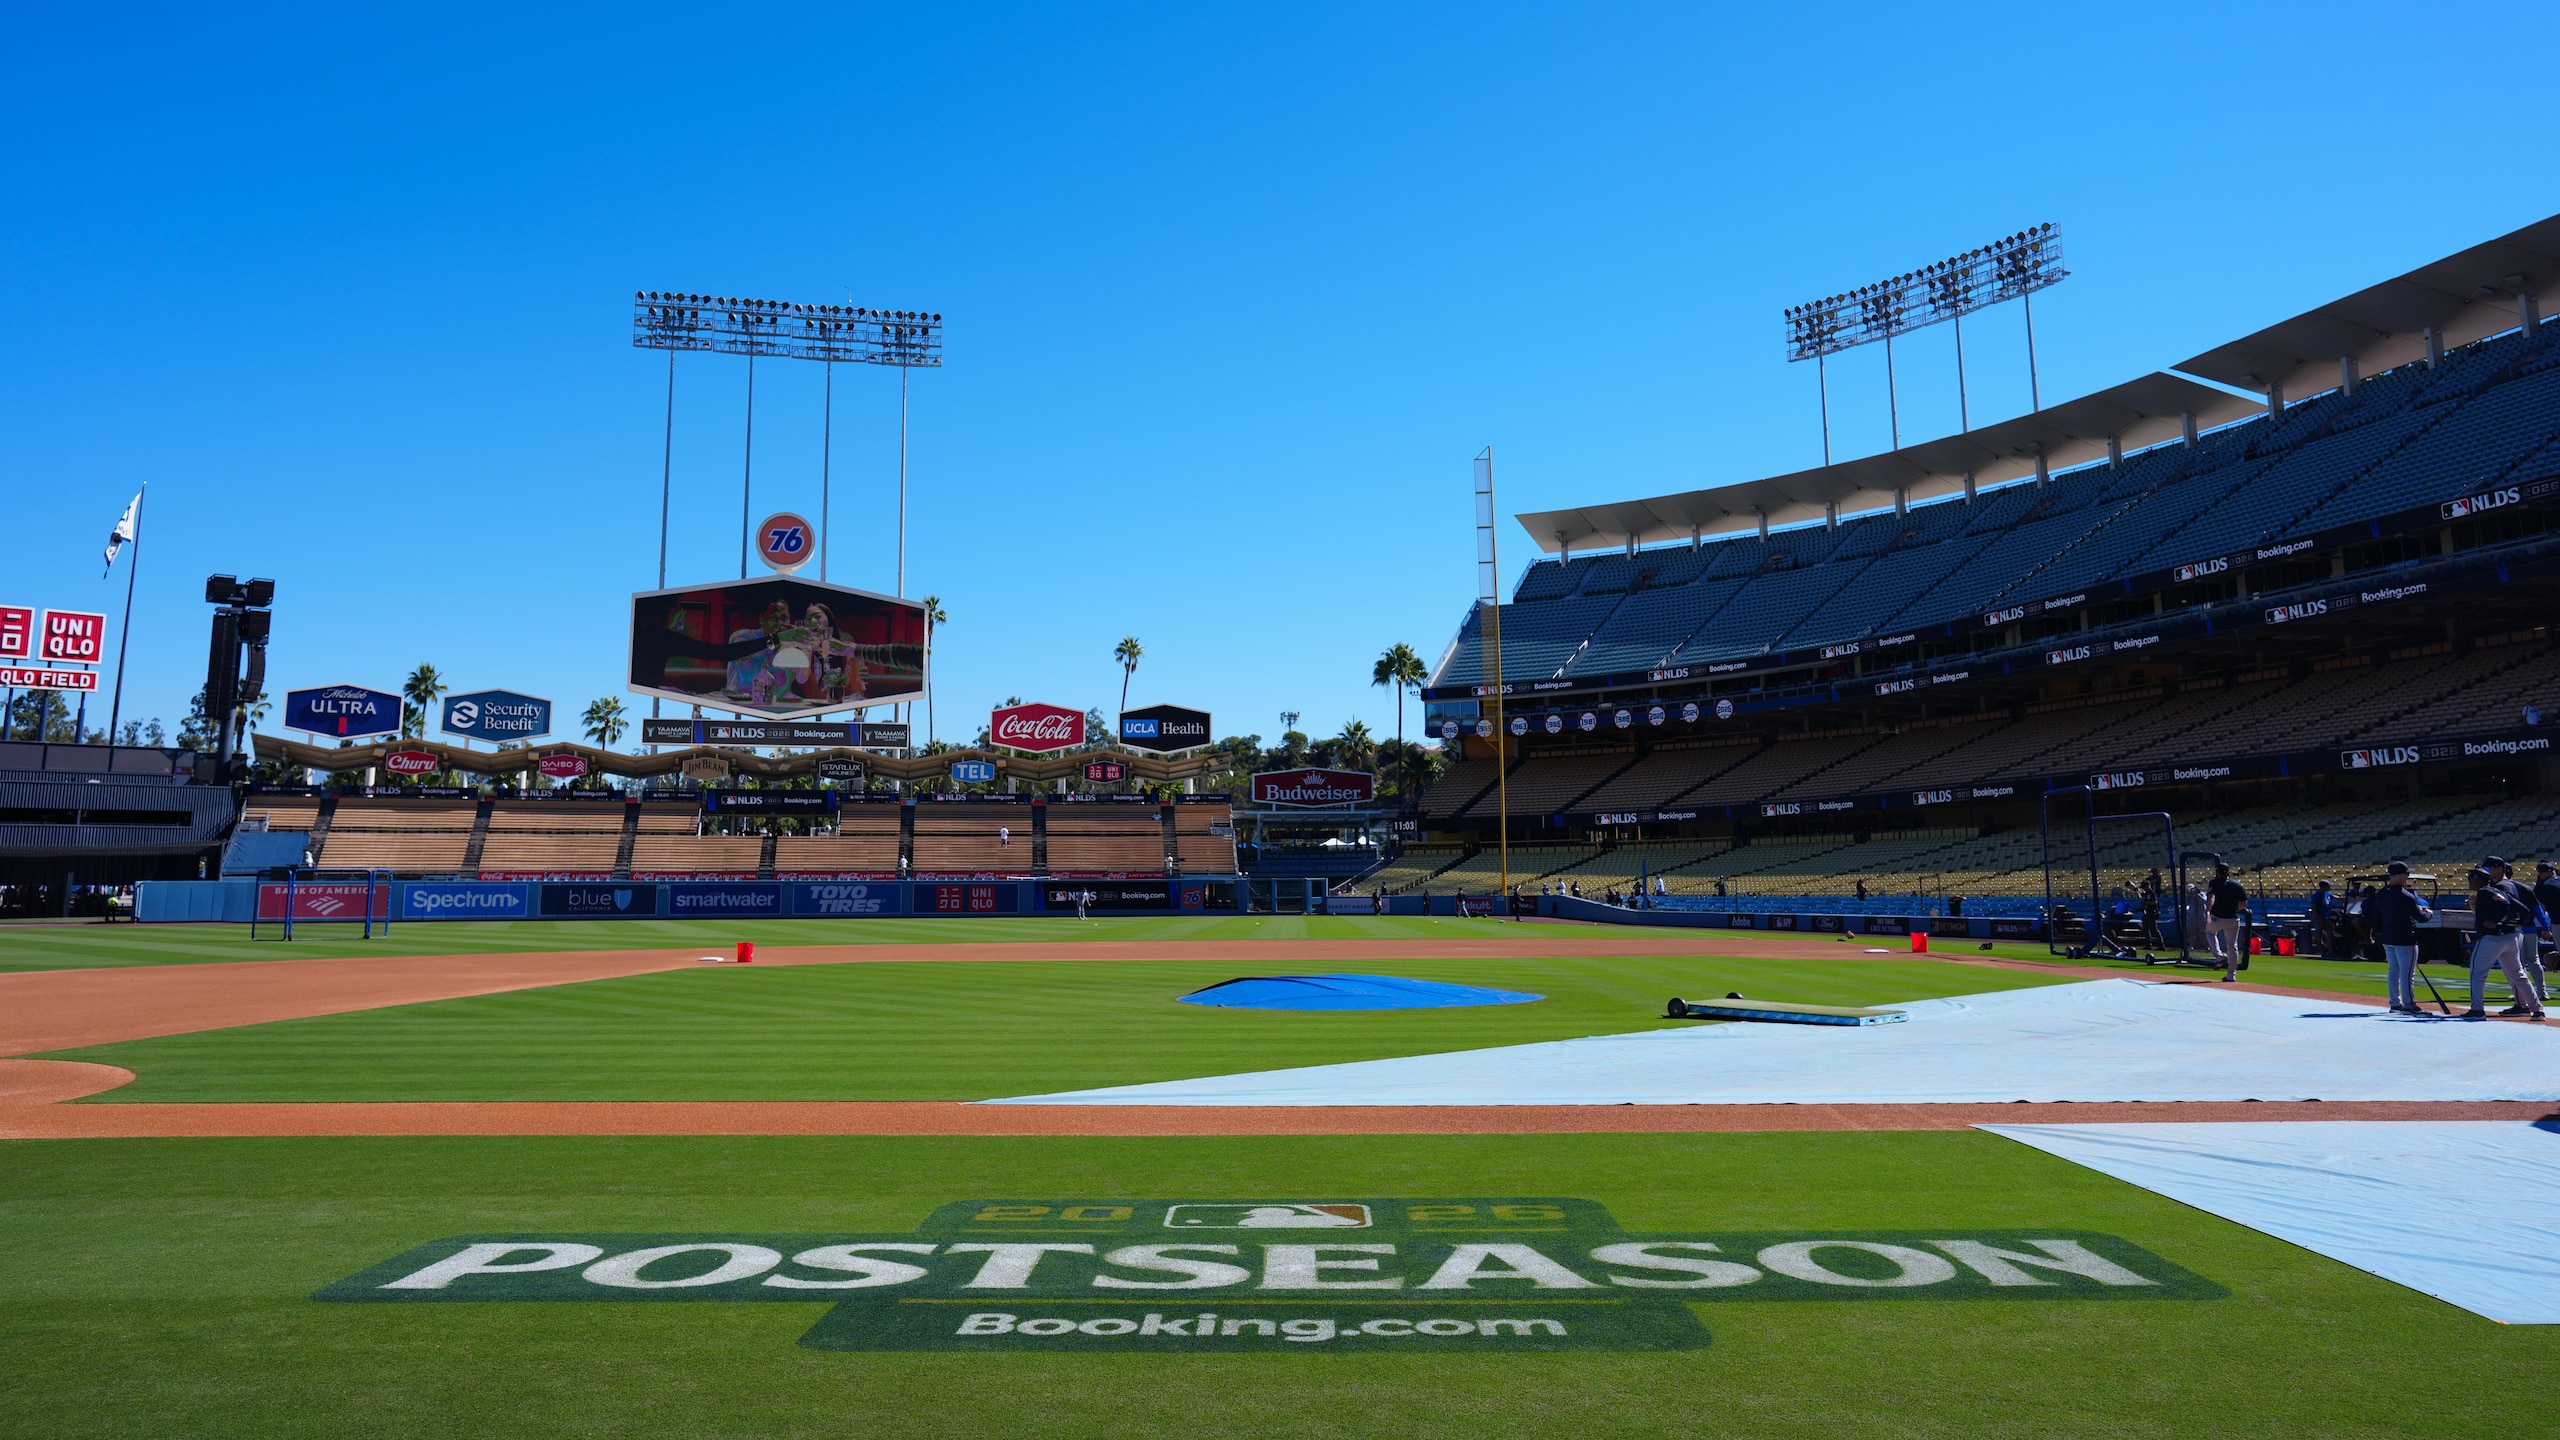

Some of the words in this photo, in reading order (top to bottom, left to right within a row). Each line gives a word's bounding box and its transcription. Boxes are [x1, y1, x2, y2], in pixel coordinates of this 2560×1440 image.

[2470, 486, 2521, 513] NLDS
[2522, 482, 2559, 497] 2026
[768, 528, 804, 554] 76
[2194, 556, 2229, 577] NLDS
[2257, 539, 2314, 560] Booking.com
[1999, 606, 2025, 623] NLDS
[2044, 593, 2086, 610] Booking.com
[2288, 599, 2328, 620] NLDS
[2361, 583, 2428, 604] Booking.com
[52, 617, 93, 637] UNI
[50, 636, 94, 656] QLO
[1834, 642, 1860, 656] NLDS
[1878, 634, 1915, 647] Booking.com
[2062, 645, 2091, 662] NLDS
[2113, 635, 2160, 651] Booking.com
[1663, 668, 1689, 679] NLDS
[1708, 662, 1747, 673] Booking.com
[40, 672, 91, 687] FIELD
[1533, 681, 1573, 690] Booking.com
[1889, 678, 1915, 693] NLDS
[1932, 671, 1969, 684] Booking.com
[322, 688, 368, 700] Michelob
[311, 699, 377, 716] ULTRA
[484, 701, 543, 718] Security
[1683, 709, 1698, 717] 2024
[1581, 718, 1595, 726] 1981
[1649, 711, 1664, 720] 2020
[484, 717, 534, 730] Benefit
[999, 714, 1076, 740] Coca-Cola
[1125, 723, 1156, 733] UCLA
[1162, 722, 1204, 735] Health
[731, 727, 766, 738] NLDS
[793, 729, 844, 740] Booking.com
[2371, 745, 2420, 766] NLDS
[2421, 746, 2459, 758] 2026
[2463, 738, 2549, 756] Booking.com
[388, 755, 435, 770] Churu
[686, 762, 702, 775] JIM
[702, 758, 724, 773] BEAM
[821, 763, 861, 771] STARLUX
[957, 765, 990, 778] TEL
[2110, 771, 2145, 788] NLDS
[2173, 766, 2231, 780] Booking.com
[376, 787, 401, 795] NLDS
[422, 788, 460, 796] Booking.com
[530, 789, 553, 797] NLDS
[572, 790, 608, 798] Booking.com
[1075, 794, 1097, 802] NLDS
[1264, 784, 1361, 801] Budweiser
[1927, 790, 1953, 804] NLDS
[1972, 786, 2014, 798] Booking.com
[738, 796, 764, 805] NLDS
[783, 797, 823, 805] Booking.com
[1776, 803, 1801, 816] NLDS
[1818, 801, 1854, 811] Booking.com
[1611, 812, 1638, 824] NLDS
[1658, 812, 1697, 821] Booking.com
[1394, 821, 1415, 830] 11:03
[309, 887, 324, 895] OF
[569, 889, 612, 906] blue
[810, 885, 868, 899] TOYO
[940, 888, 960, 898] ユニ
[972, 888, 992, 897] UNI
[1121, 891, 1165, 900] Booking.com
[1183, 891, 1200, 903] 76
[412, 890, 513, 912] Spectrum
[676, 892, 776, 907] smartwater
[819, 899, 881, 912] TIRES
[972, 899, 993, 909] QLO
[1462, 901, 1491, 909] akult
[1732, 917, 1751, 927] Adobe
[1783, 918, 1792, 927] APP
[1881, 924, 1902, 933] OCTOBER
[1939, 922, 1966, 931] BETMGM
[973, 1205, 1134, 1221] 20
[375, 1239, 2164, 1290] POSTSEASON
[955, 1312, 1569, 1342] Booking.com
